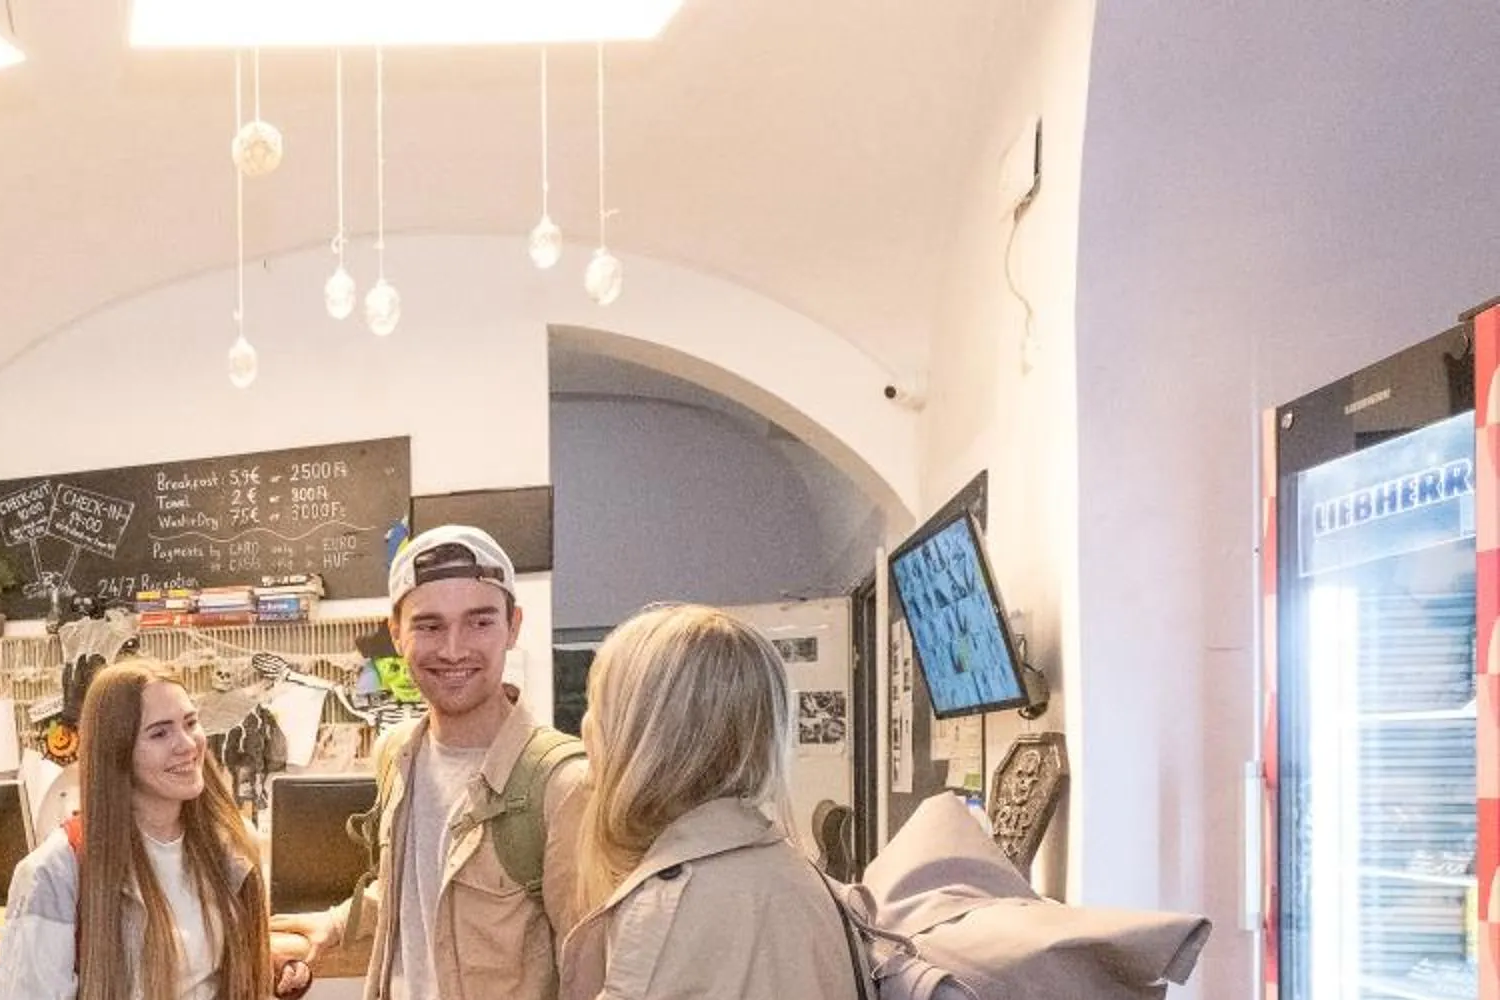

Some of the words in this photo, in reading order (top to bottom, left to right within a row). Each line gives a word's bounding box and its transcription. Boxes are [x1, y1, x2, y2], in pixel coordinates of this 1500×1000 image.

[1316, 459, 1473, 536] LIEBHERR
[323, 551, 351, 569] HUF
[99, 576, 135, 599] 24/7
